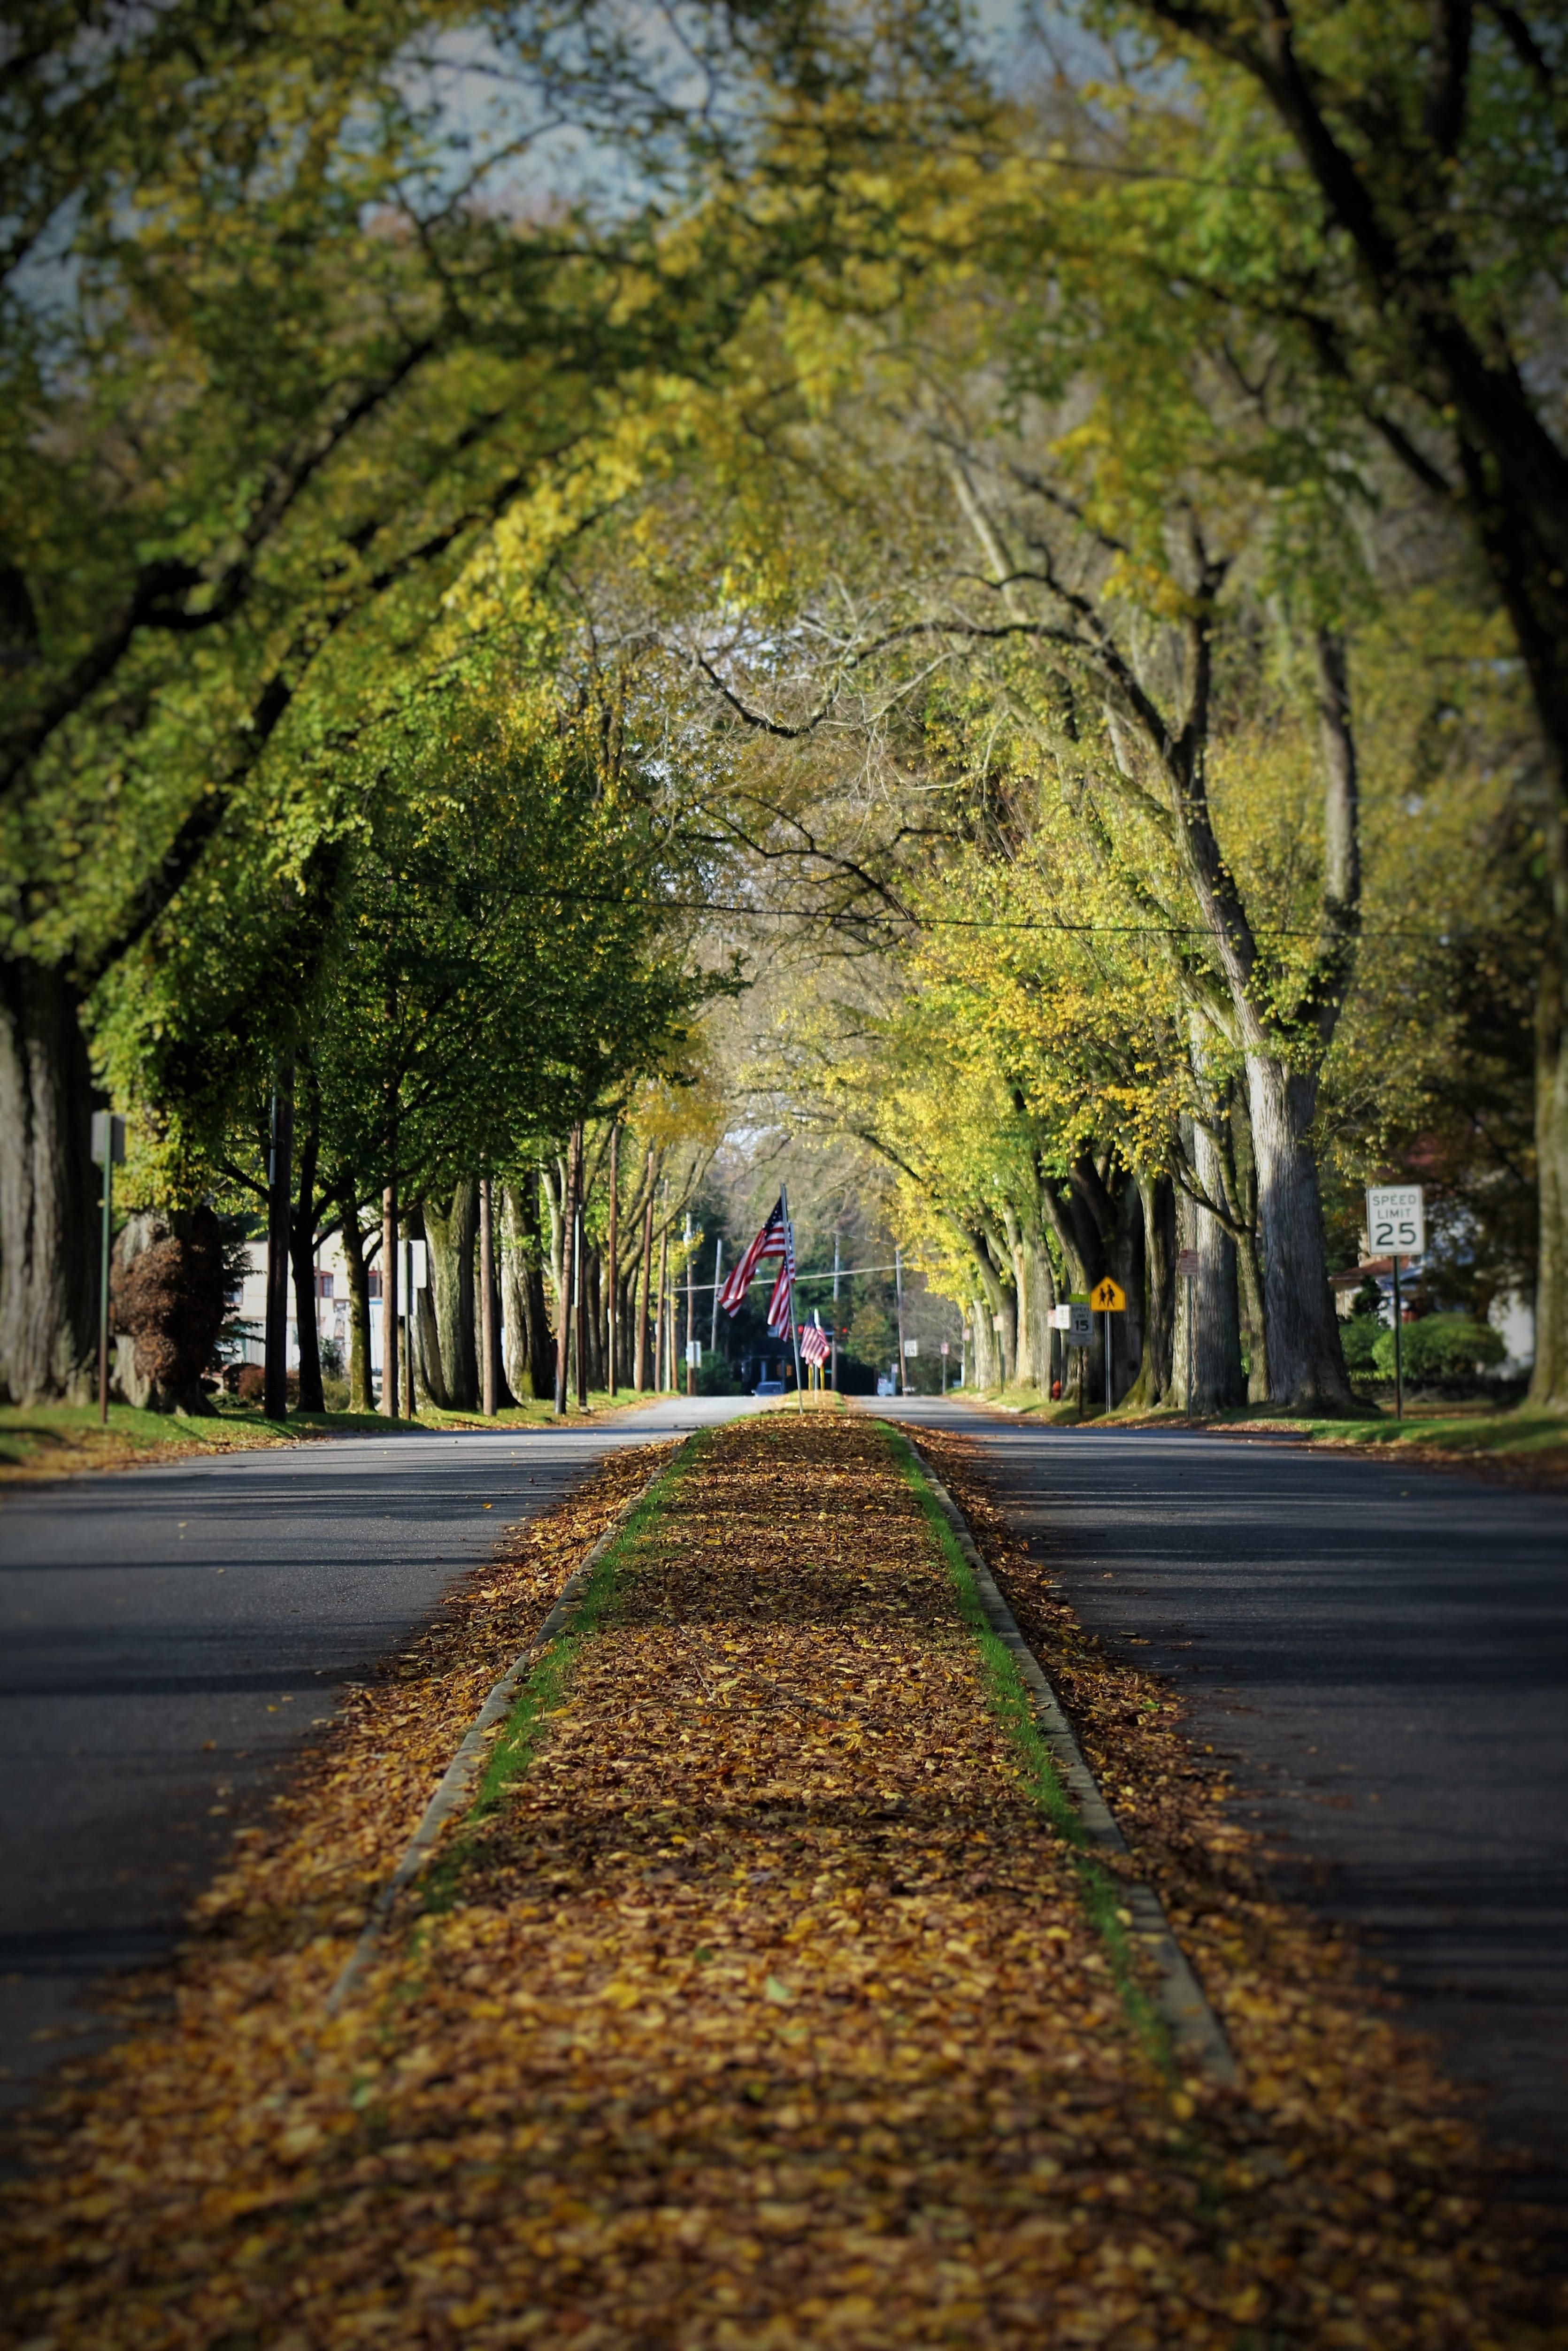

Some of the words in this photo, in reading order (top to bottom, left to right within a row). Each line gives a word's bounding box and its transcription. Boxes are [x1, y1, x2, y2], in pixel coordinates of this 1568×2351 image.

[1373, 1195, 1416, 1206] SPEED
[1377, 1208, 1411, 1219] LIMIT
[1376, 1222, 1416, 1245] 25
[1075, 1320, 1089, 1331] 15
